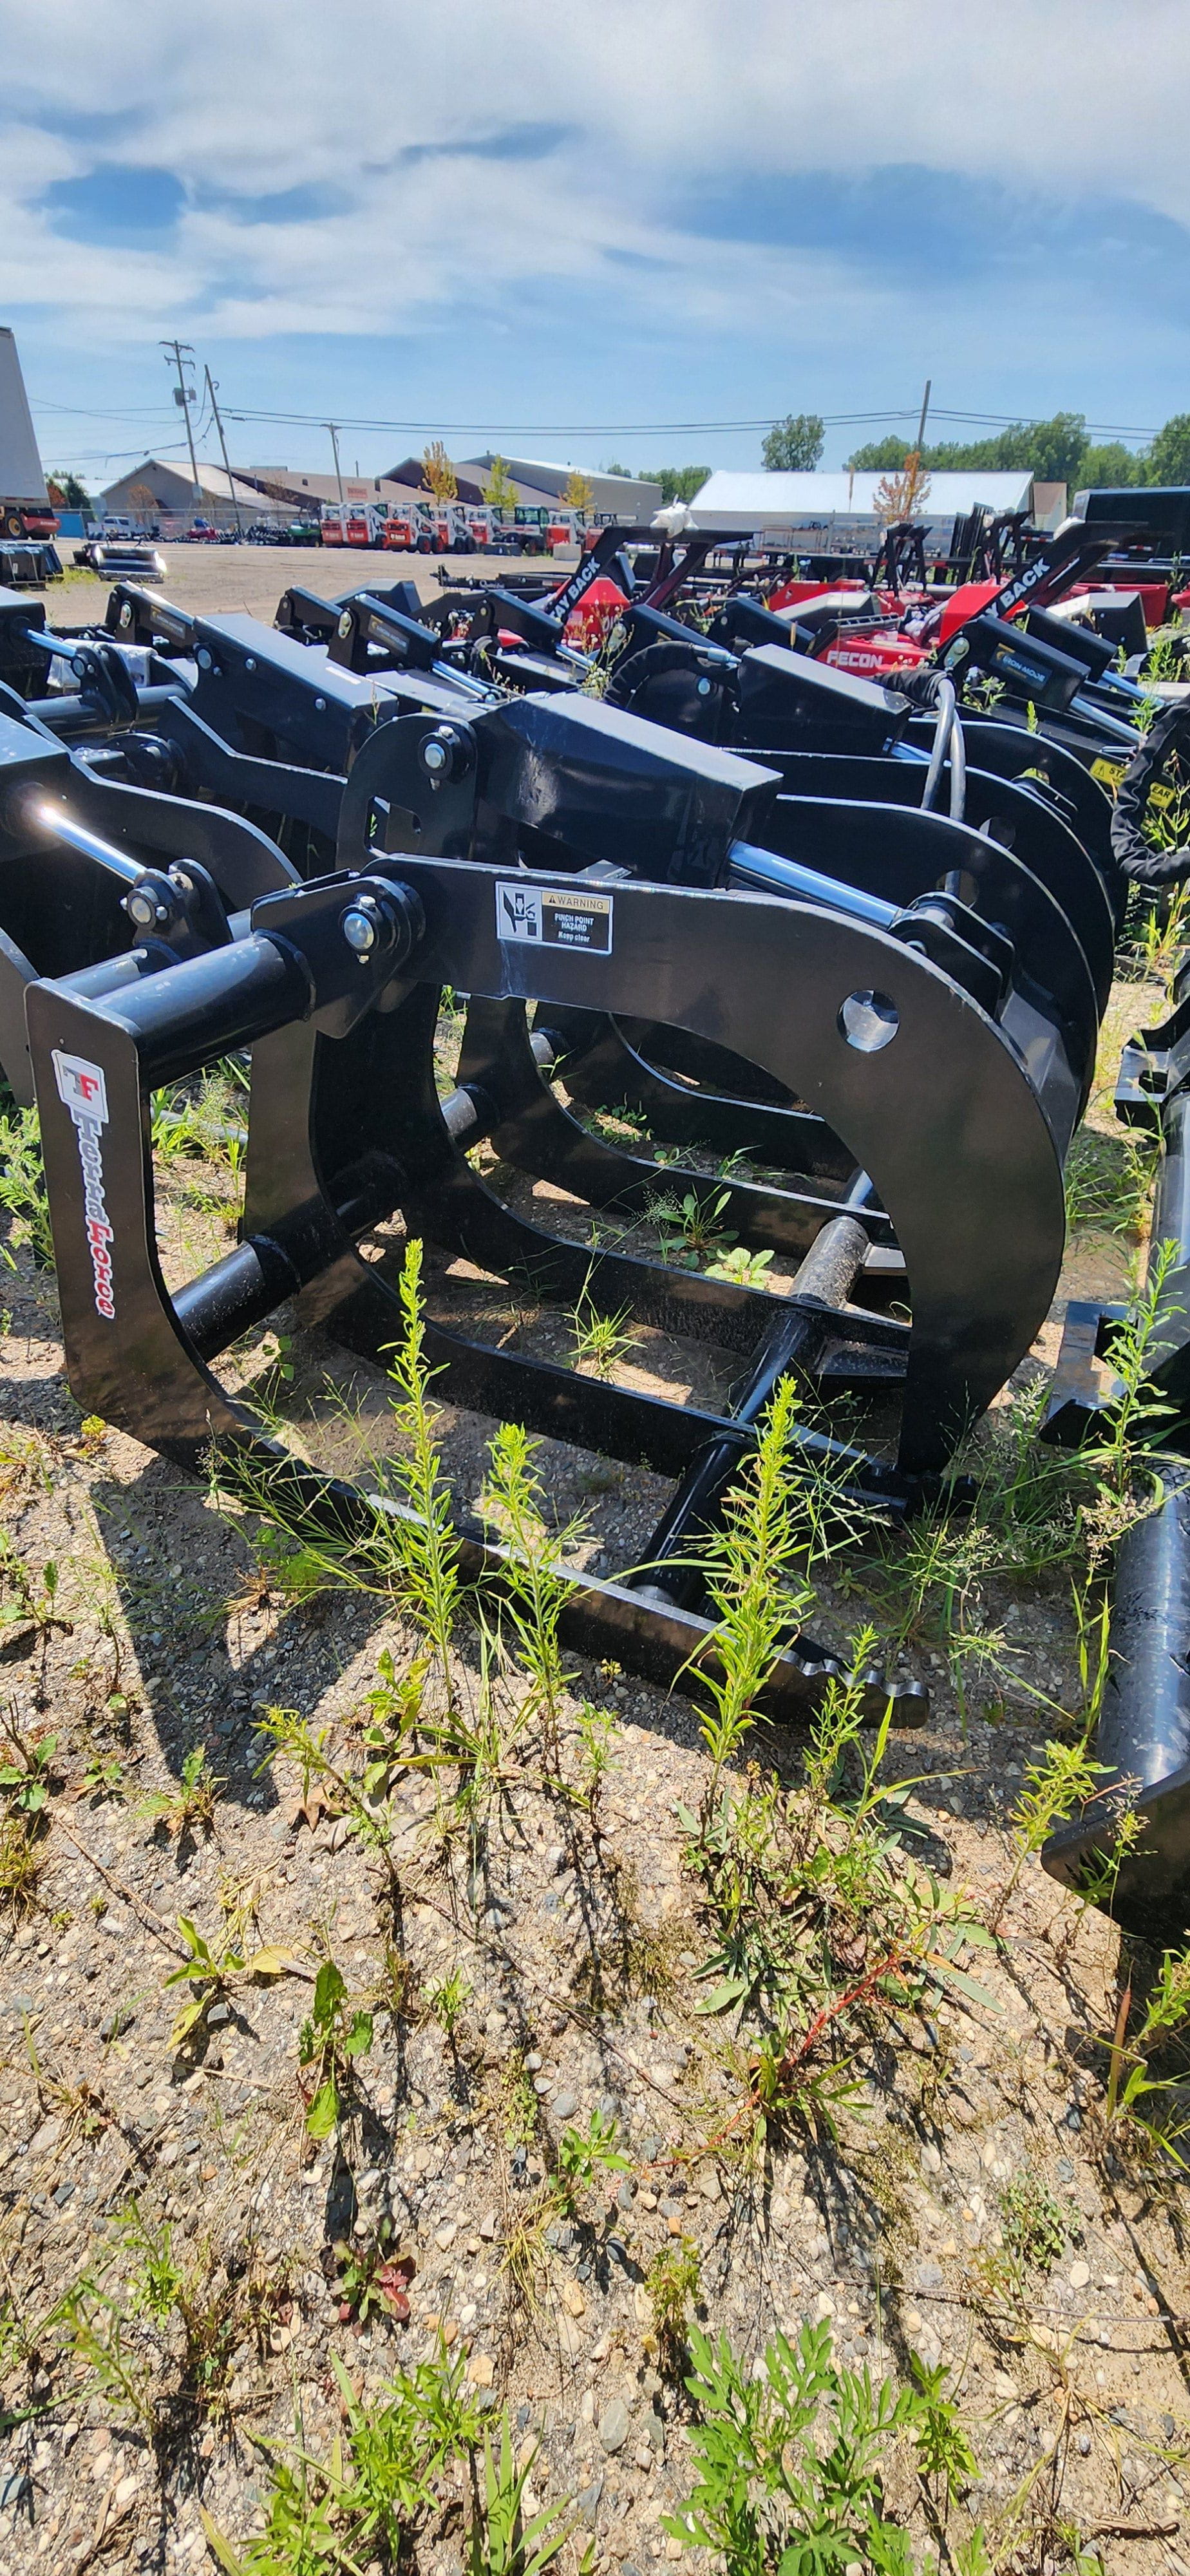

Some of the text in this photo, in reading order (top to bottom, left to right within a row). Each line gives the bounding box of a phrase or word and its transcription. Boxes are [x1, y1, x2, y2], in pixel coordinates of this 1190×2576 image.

[568, 556, 600, 600] BACK
[999, 557, 1050, 608] BACK
[827, 650, 883, 668] FECON
[1153, 786, 1171, 799] EAR
[558, 896, 603, 910] WARNING
[554, 913, 594, 926] PINCH POINT
[562, 922, 587, 932] HAZARD
[558, 931, 574, 942] Keep
